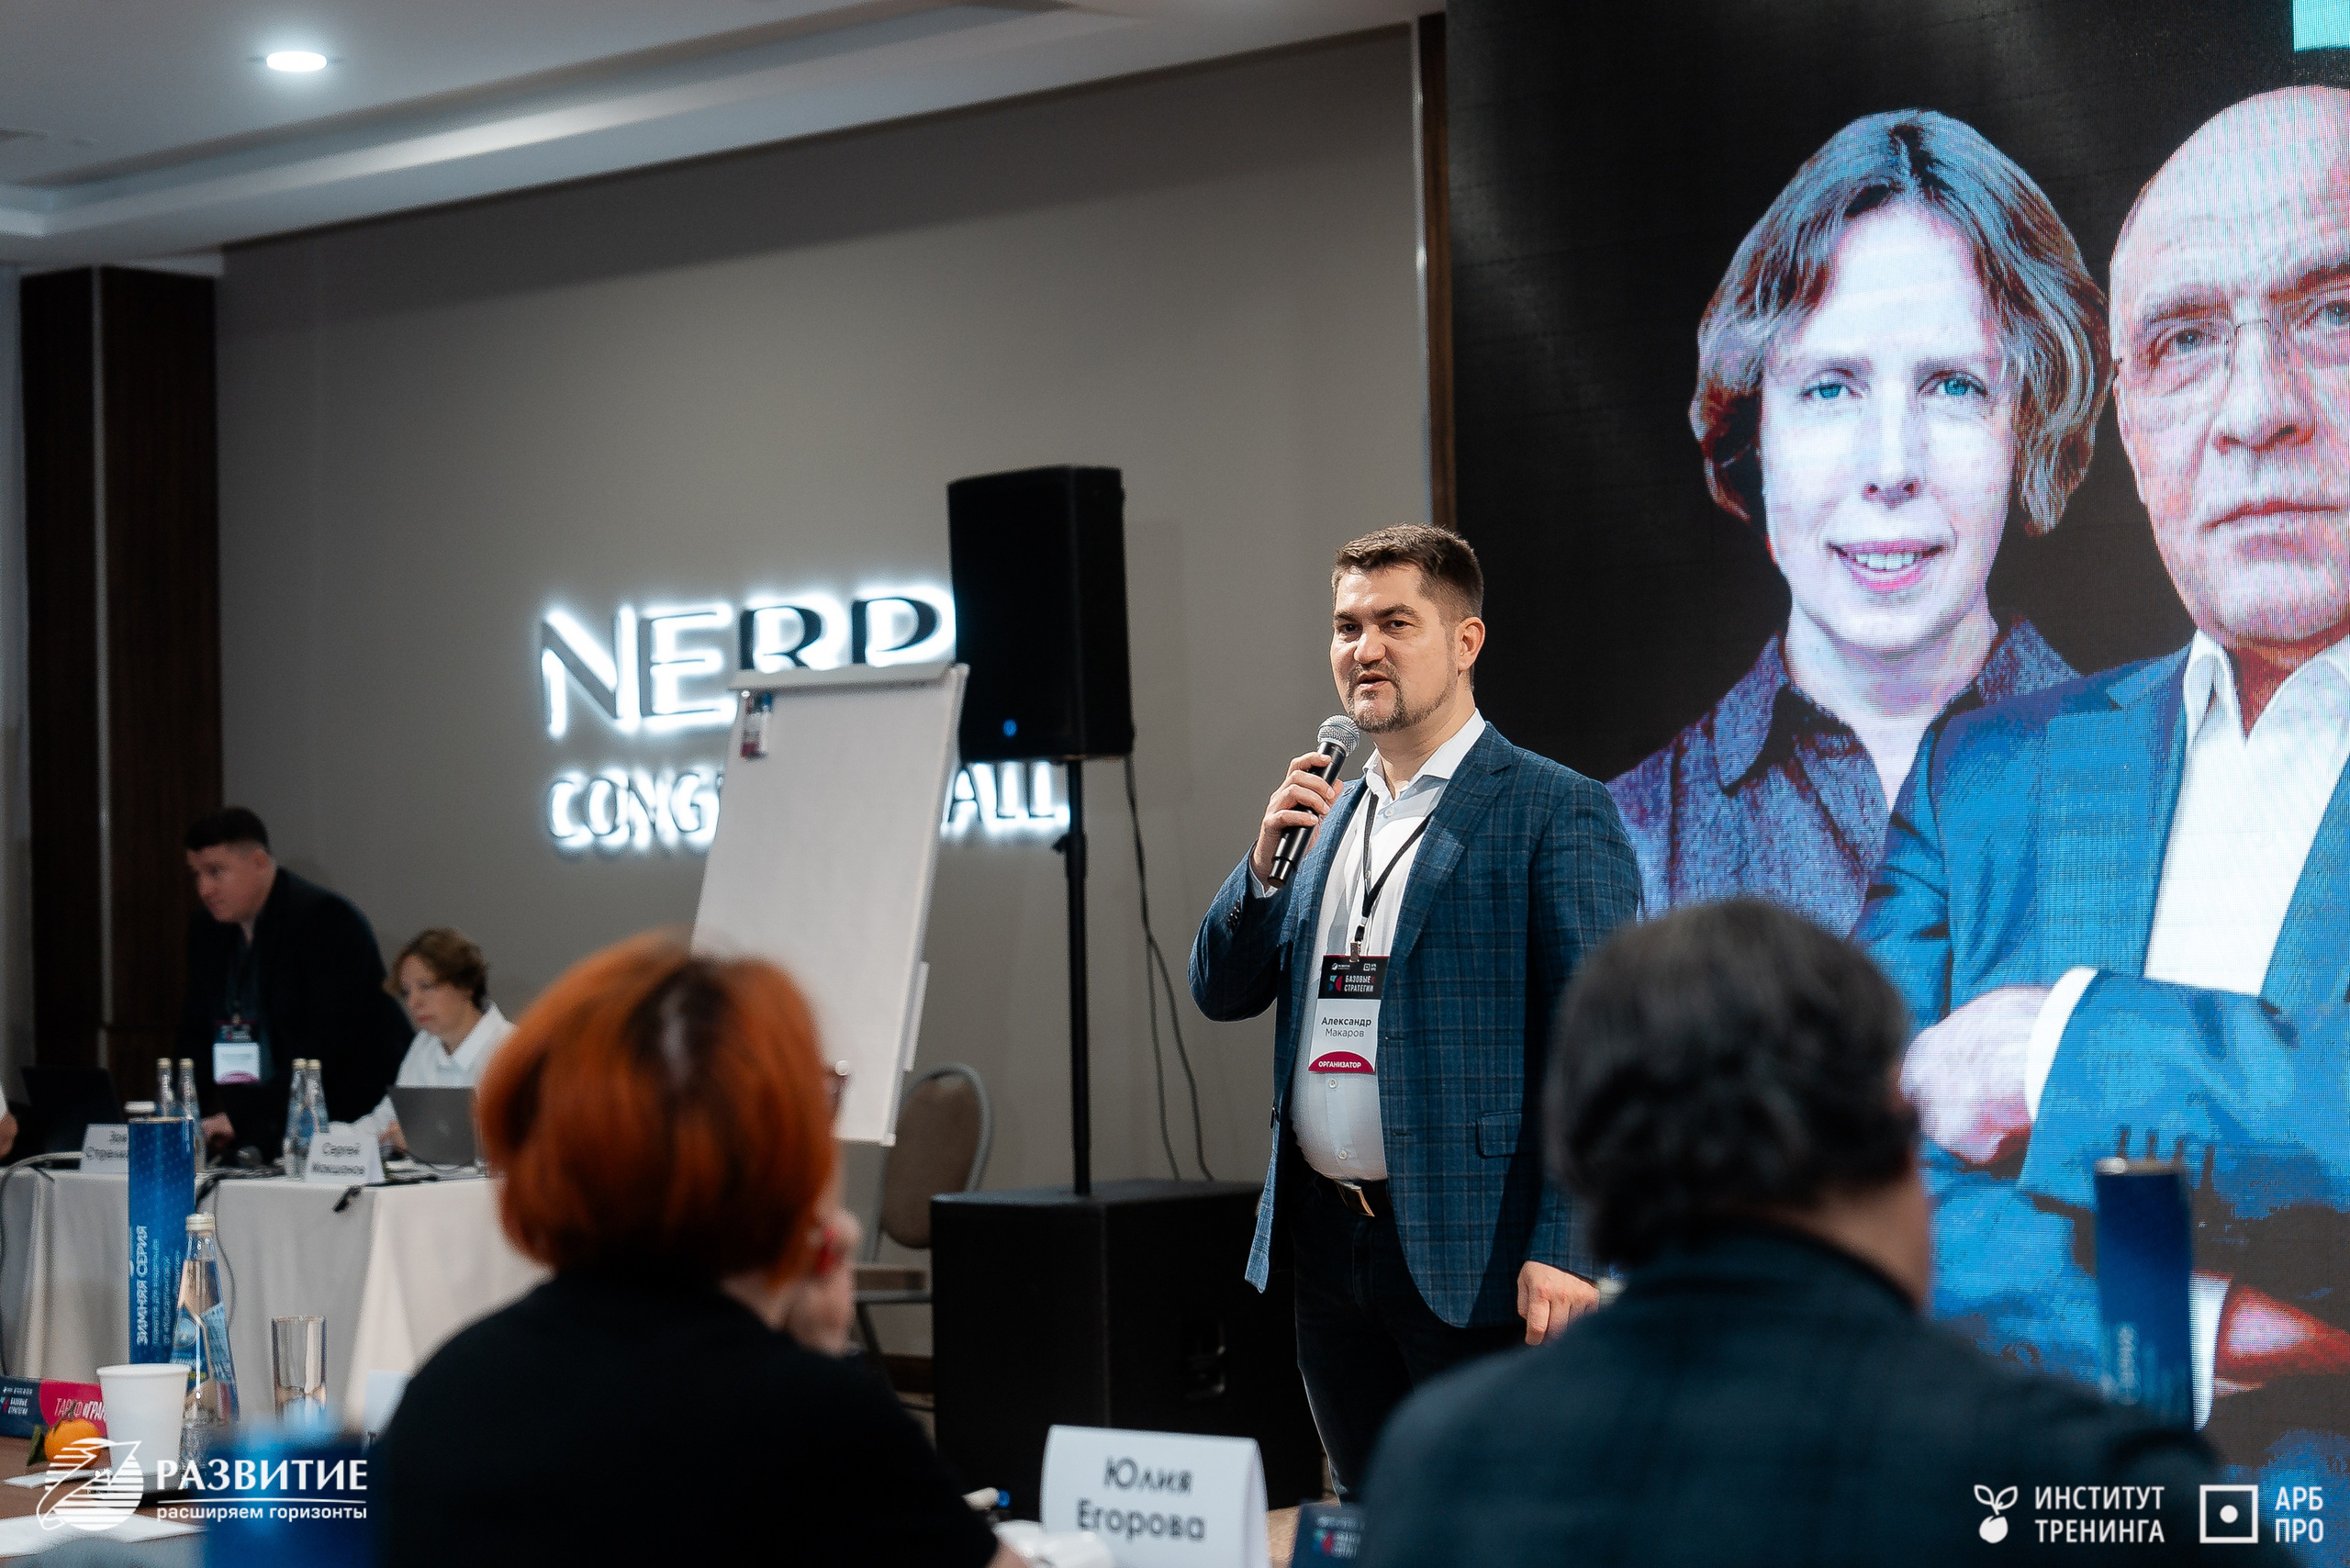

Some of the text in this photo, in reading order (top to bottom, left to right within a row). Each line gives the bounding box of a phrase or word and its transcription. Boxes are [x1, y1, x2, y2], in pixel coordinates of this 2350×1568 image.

[548, 769, 723, 845] CONG
[1345, 975, 1371, 983] БАЗОВЫЕ
[1344, 984, 1374, 992] СТРАТЕГИИ
[1321, 1016, 1372, 1027] Александр
[1325, 1027, 1365, 1039] Макаров
[1318, 1060, 1361, 1069] ОРГАНИЗАТОР
[136, 1225, 148, 1346] ЗИМНЯЯ СЕРИЯ
[1103, 1456, 1192, 1494] Юлия
[1077, 1498, 1206, 1541] Егорова
